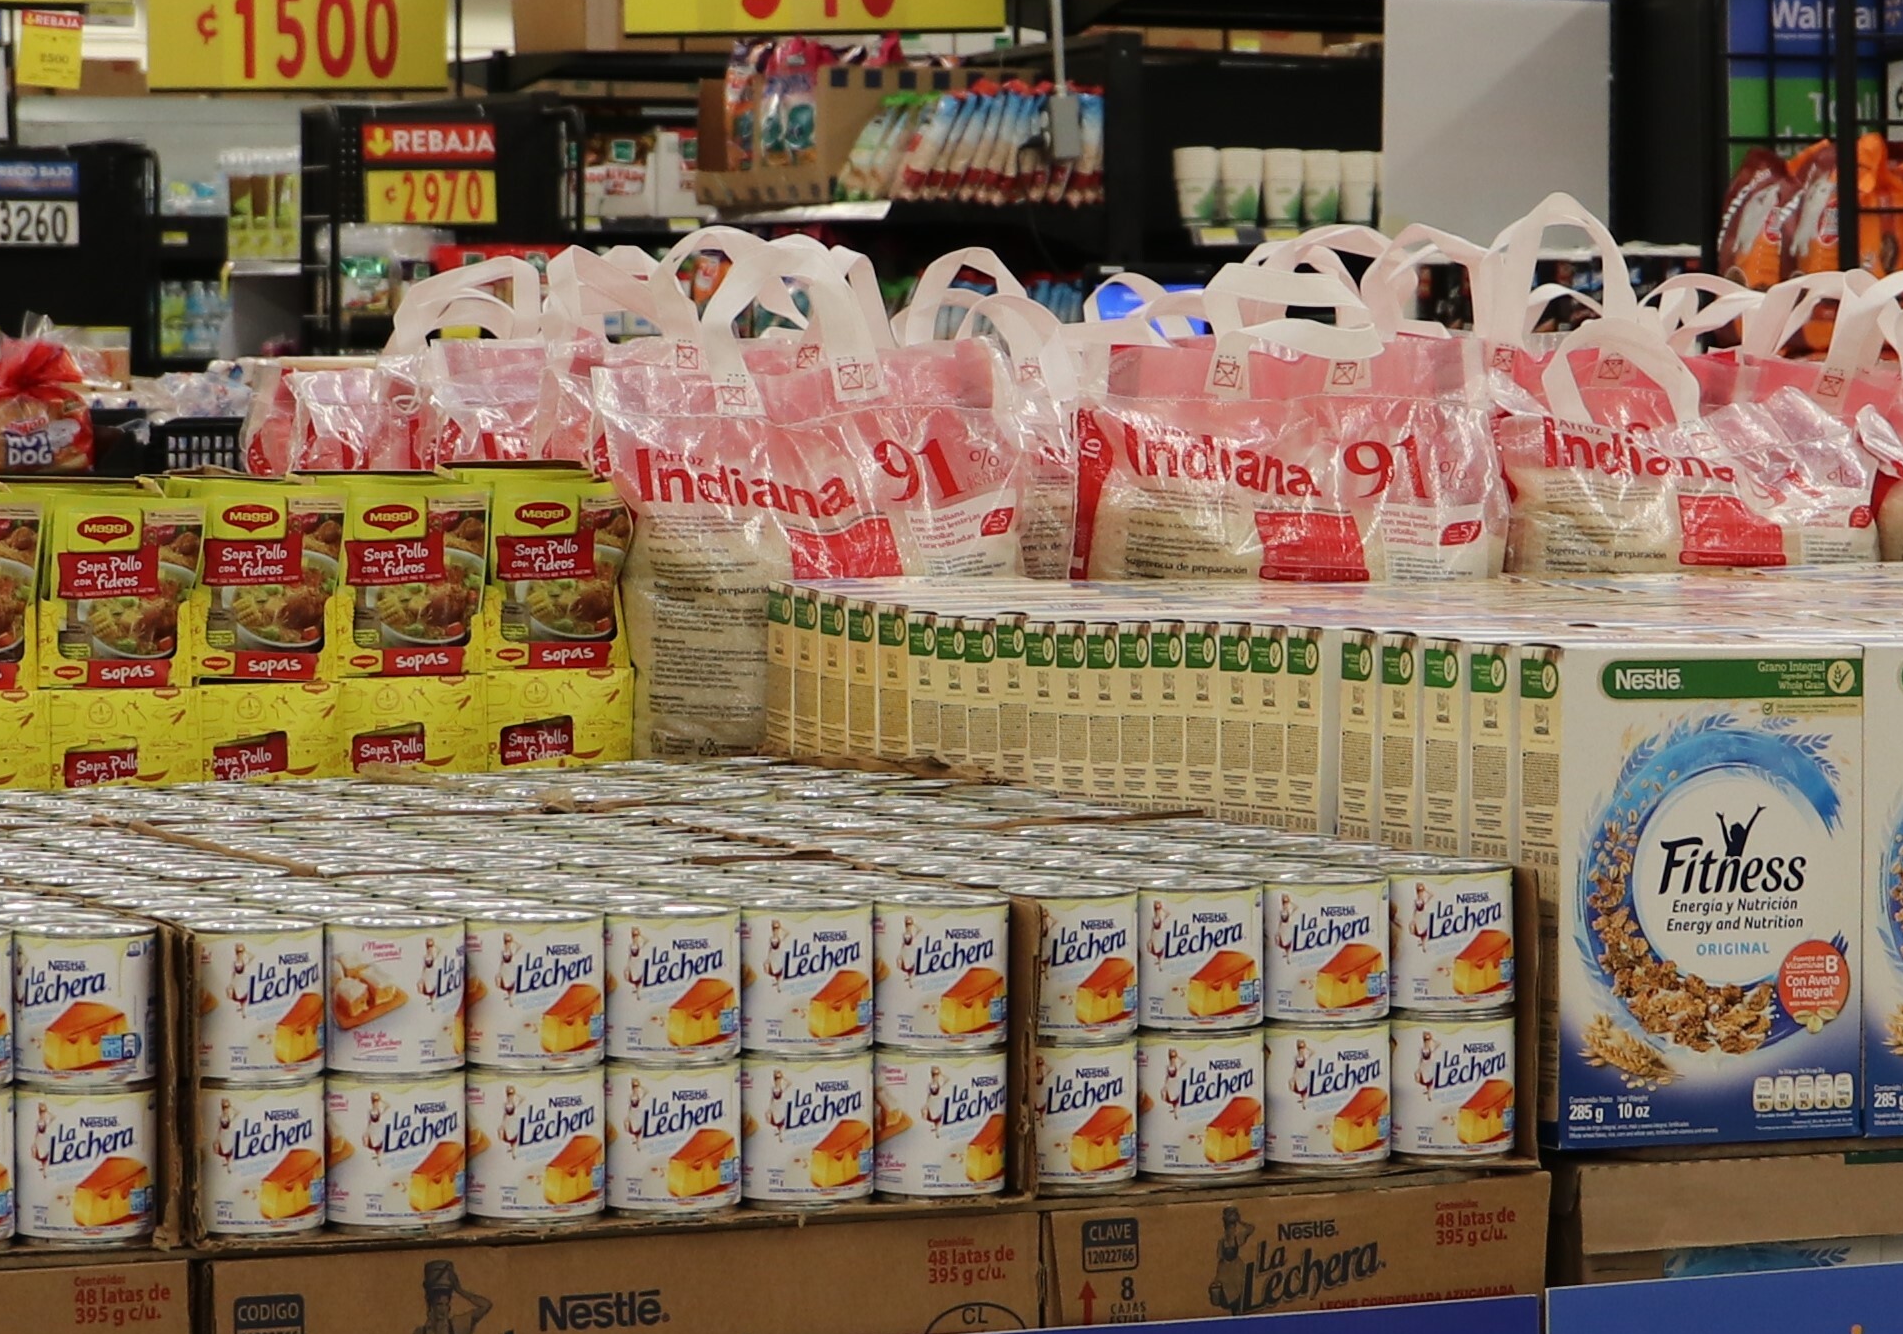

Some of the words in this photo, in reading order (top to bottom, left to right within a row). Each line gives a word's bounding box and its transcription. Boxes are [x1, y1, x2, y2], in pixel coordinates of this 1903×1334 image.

[35, 14, 82, 28] REBAJA
[393, 129, 495, 154] REBAJA
[635, 448, 854, 519] Indiana
[874, 438, 964, 502] 91
[1615, 668, 1681, 691] Nestlé
[1658, 836, 1806, 895] Fitness
[1672, 896, 1721, 914] Energía
[1725, 901, 1732, 914] y
[1739, 895, 1798, 913] Nutrición
[1666, 918, 1712, 935] Energy
[1716, 916, 1739, 931] and
[1745, 914, 1804, 930] Nutrition
[1696, 942, 1770, 956] ORIGINAL
[75, 1286, 96, 1306] 48
[100, 1284, 144, 1304] latas
[147, 1283, 171, 1302] de
